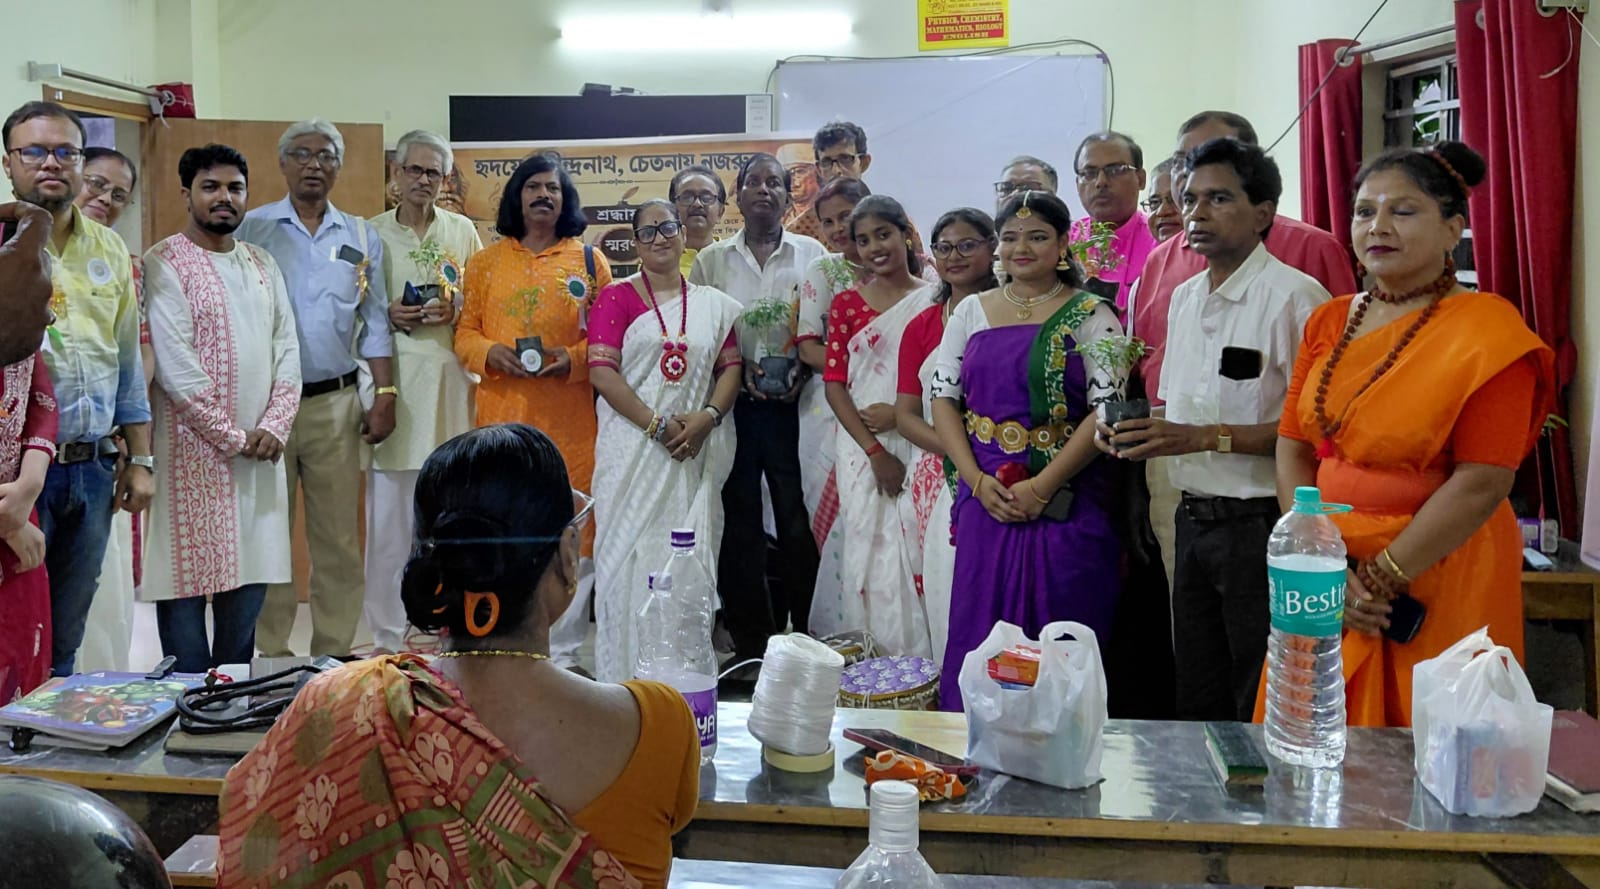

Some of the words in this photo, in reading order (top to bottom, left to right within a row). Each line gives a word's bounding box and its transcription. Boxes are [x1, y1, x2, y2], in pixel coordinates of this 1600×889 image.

[975, 23, 1003, 31] BIOLOGY
[943, 32, 989, 40] ENGLISH
[699, 152, 750, 170] নজরু
